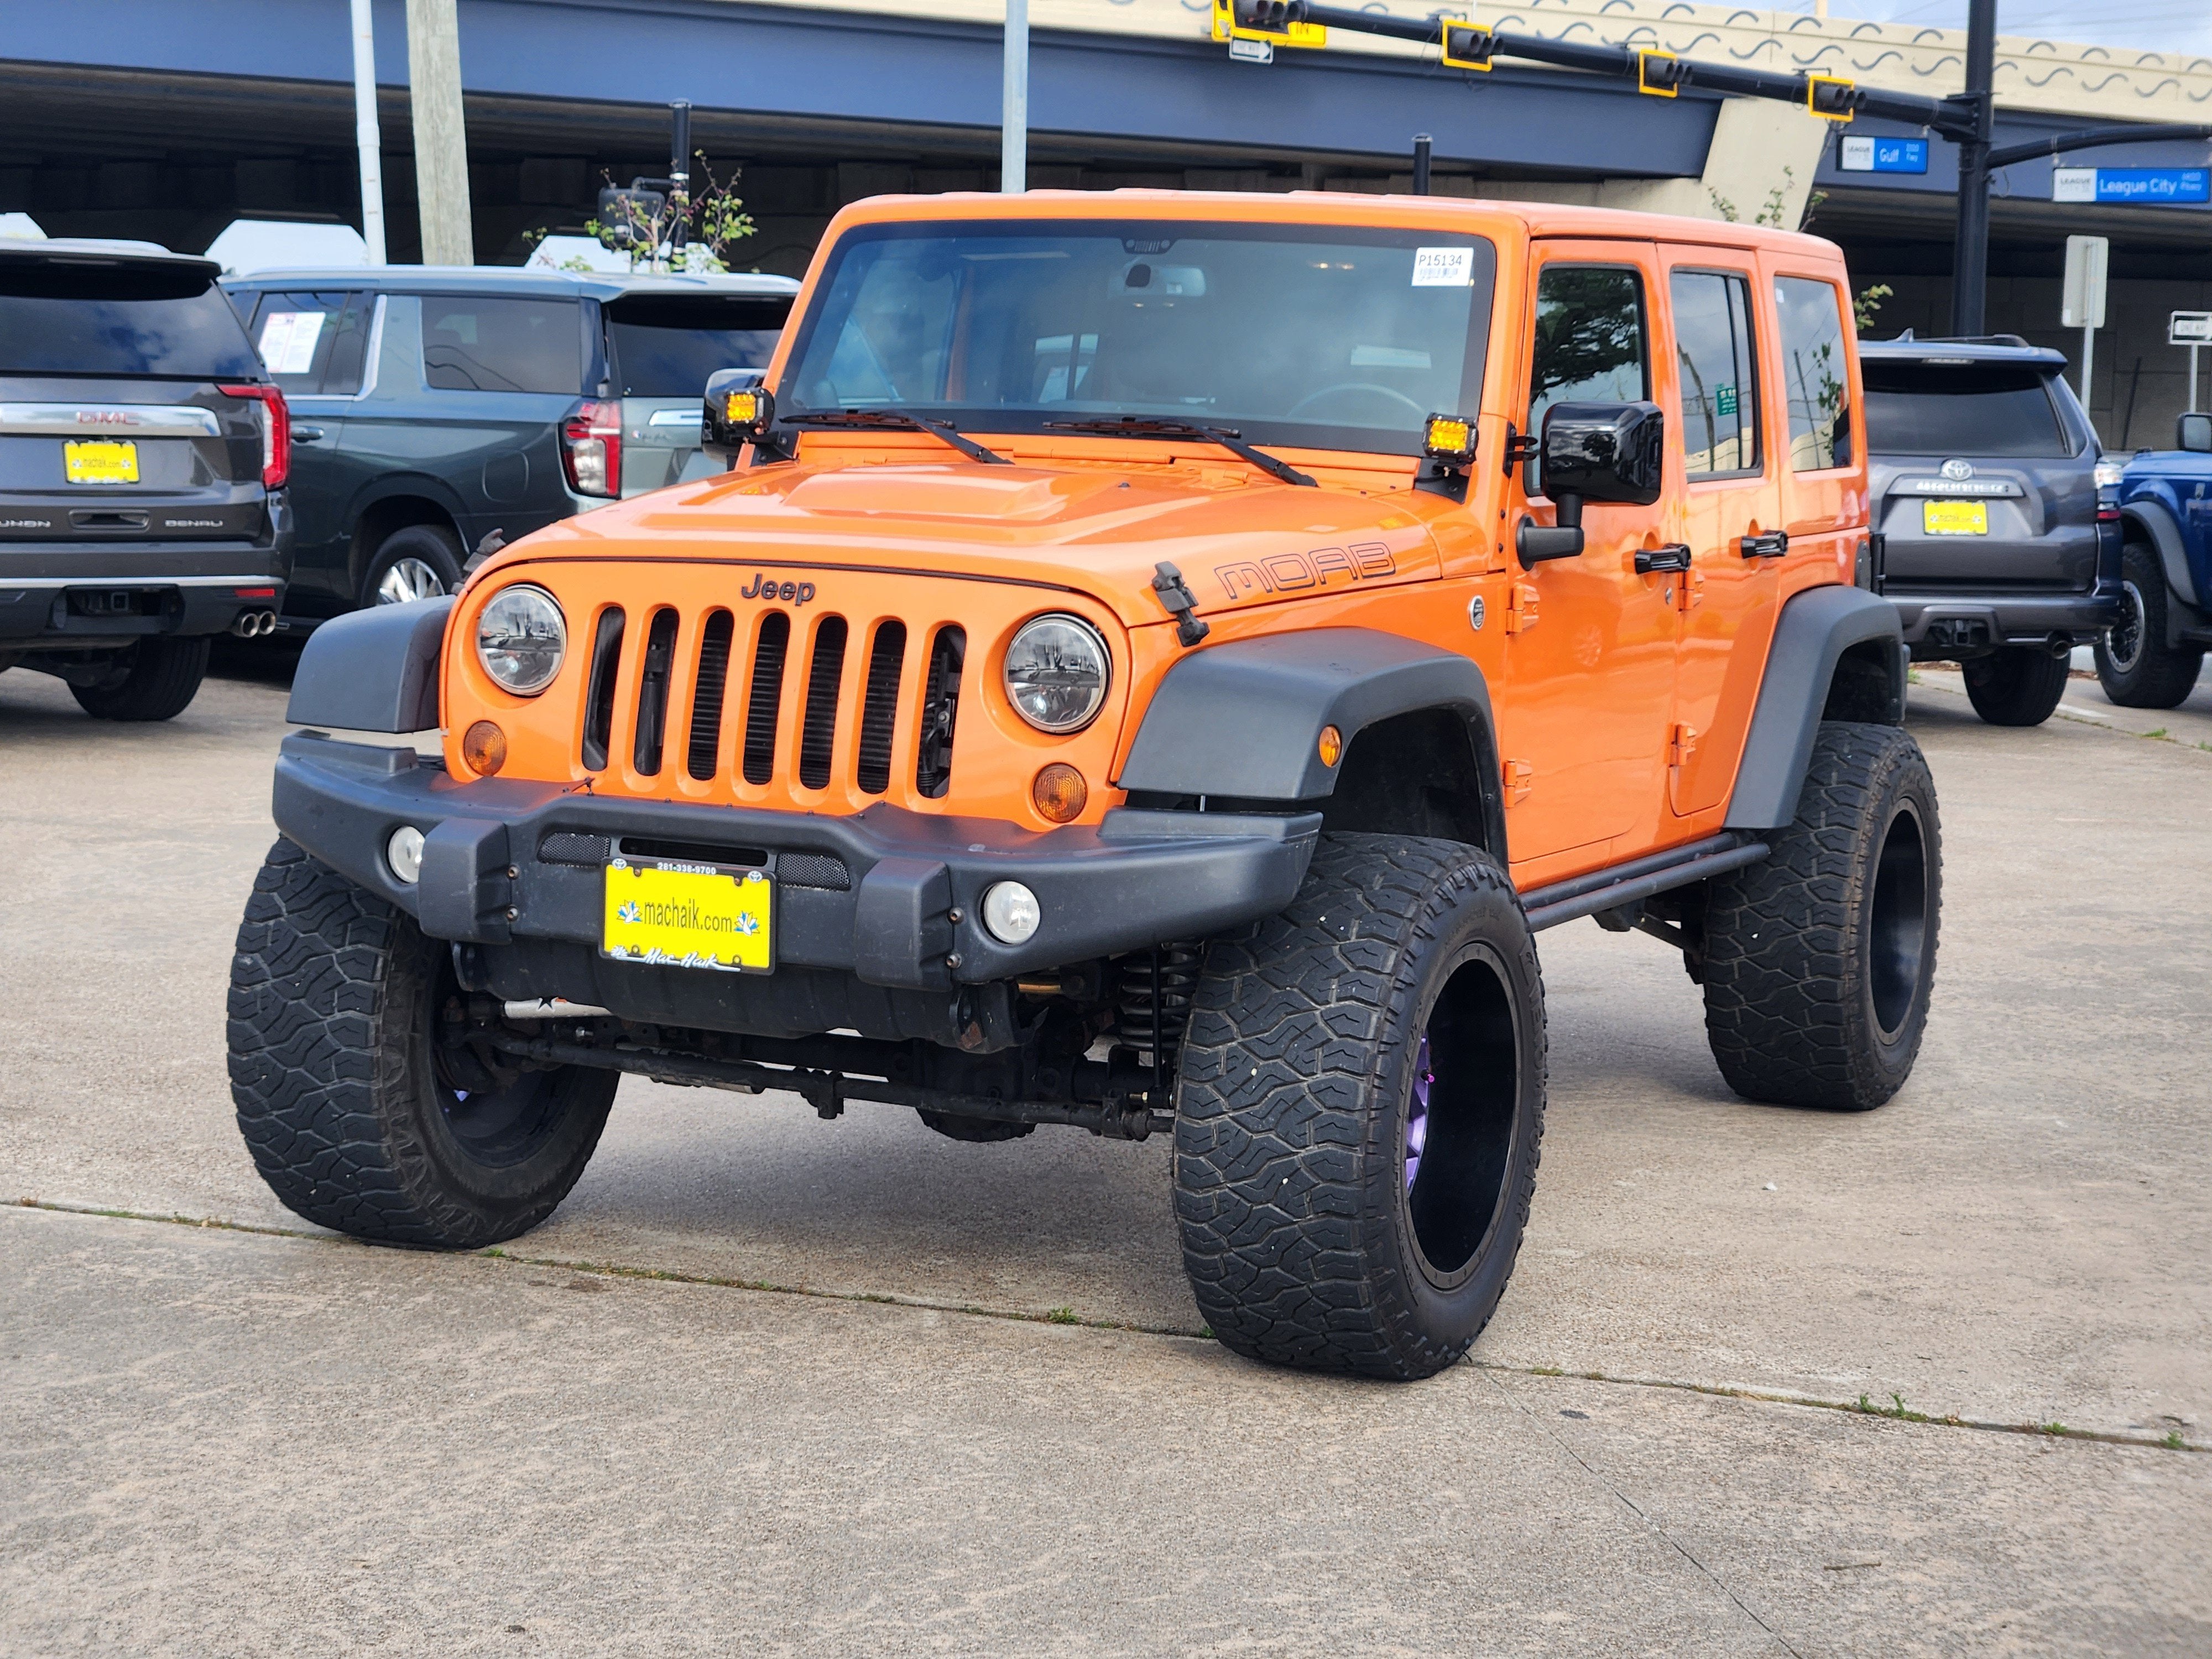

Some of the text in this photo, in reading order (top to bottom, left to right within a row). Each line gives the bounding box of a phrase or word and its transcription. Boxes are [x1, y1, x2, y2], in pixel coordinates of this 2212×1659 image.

[1880, 148, 1900, 163] Gulf
[2099, 178, 2178, 196] League City
[1418, 254, 1462, 266] P15134
[76, 411, 139, 425] GMC
[1213, 542, 1396, 599] MOAB
[741, 573, 816, 607] Jeep
[644, 897, 732, 933] machaik.com
[644, 947, 719, 968] Mac Haik
